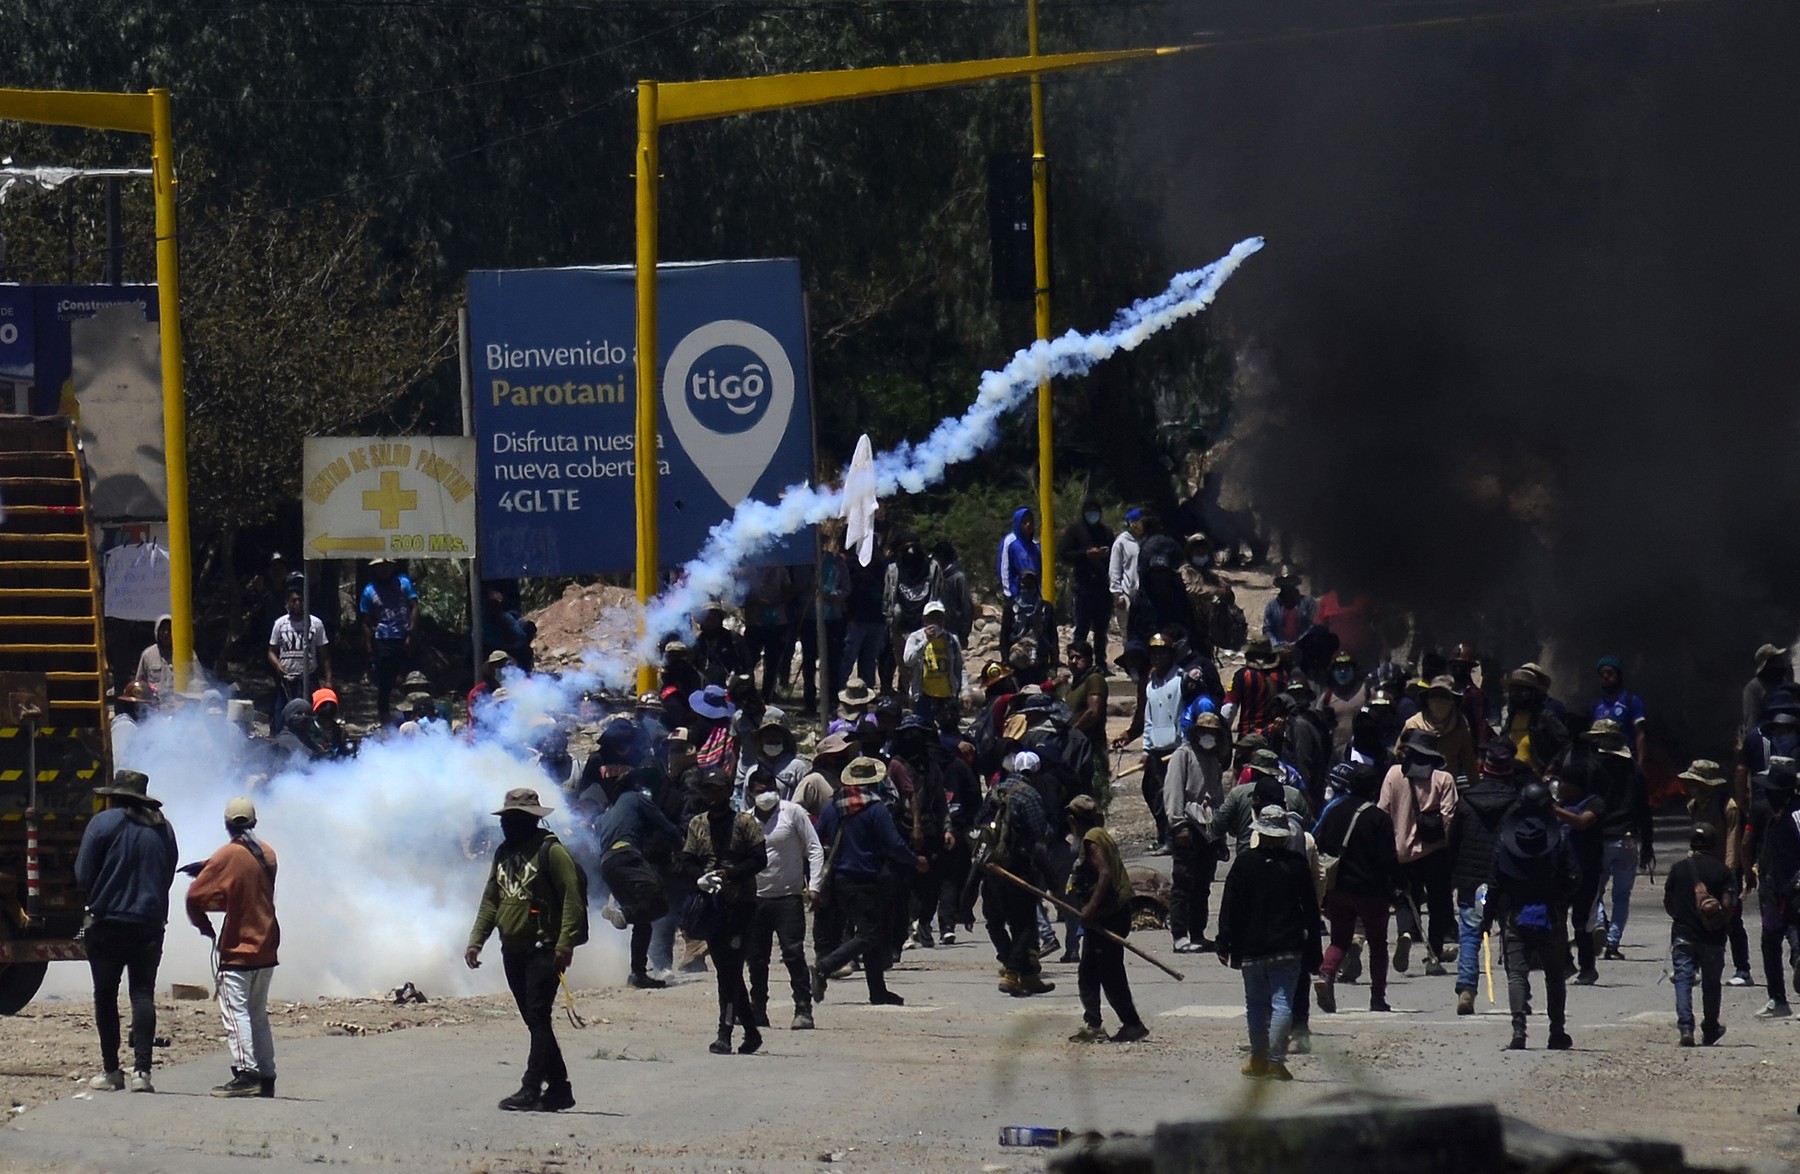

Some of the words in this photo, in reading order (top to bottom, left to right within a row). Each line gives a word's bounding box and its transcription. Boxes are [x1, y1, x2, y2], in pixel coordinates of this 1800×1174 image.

[486, 339, 626, 371] Bienvenido
[491, 374, 625, 407] Parotani
[493, 430, 578, 454] Disfruta
[584, 433, 664, 452] nuesa
[494, 463, 560, 480] nueva
[498, 489, 581, 513] 4GLTE
[390, 534, 425, 553] 500
[428, 534, 469, 553] Mts.
